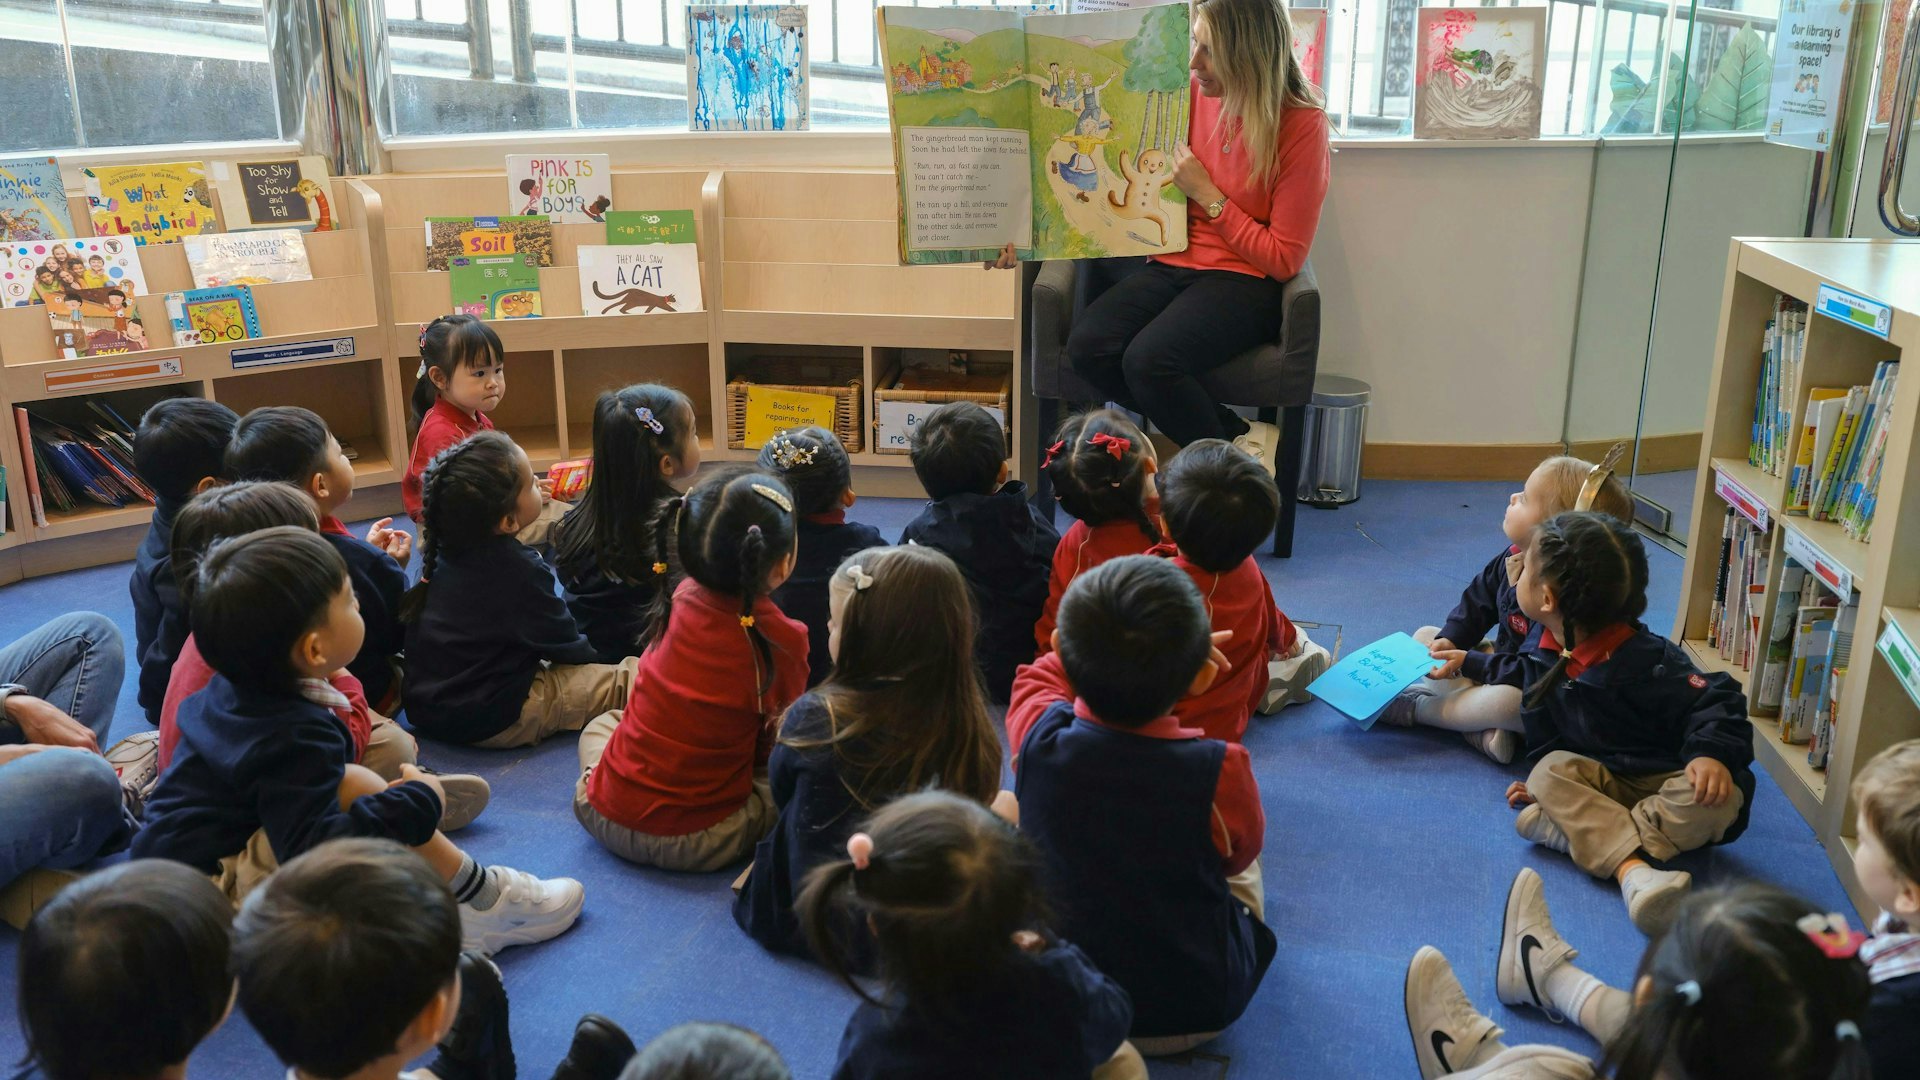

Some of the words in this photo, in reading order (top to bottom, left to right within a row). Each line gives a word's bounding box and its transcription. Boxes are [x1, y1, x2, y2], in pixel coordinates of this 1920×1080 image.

[1792, 24, 1805, 36] Our
[1806, 24, 1832, 42] library
[1834, 26, 1840, 38] is
[1794, 41, 1800, 50] a
[1801, 40, 1832, 57] learning
[1799, 56, 1822, 69] space!
[911, 134, 924, 142] The
[925, 134, 966, 144] gingerbread
[986, 135, 998, 144] kept
[246, 167, 267, 176] Too
[270, 164, 292, 179] Shy
[574, 160, 593, 177] IS
[0, 172, 42, 188] innie
[120, 172, 146, 182] Donaldson
[264, 176, 278, 184] for
[124, 182, 168, 204] What
[257, 184, 289, 196] Show
[940, 184, 974, 192] gingerbread
[8, 188, 50, 202] Winter
[268, 196, 284, 204] and
[144, 202, 160, 212] the
[268, 206, 288, 216] Tell
[542, 196, 585, 214] BOYS
[114, 211, 196, 236] Ladybird
[470, 236, 506, 252] Soil
[918, 235, 928, 243] got
[616, 254, 632, 264] THEY
[636, 254, 646, 262] ALL
[650, 254, 664, 264] SAW
[617, 266, 626, 286] A
[632, 264, 662, 288] CAT
[164, 362, 178, 374] 中文
[773, 402, 794, 412] Books
[797, 404, 810, 412] for
[766, 414, 800, 424] repairing
[1368, 649, 1396, 664] Happy
[1358, 658, 1398, 684] Birthday
